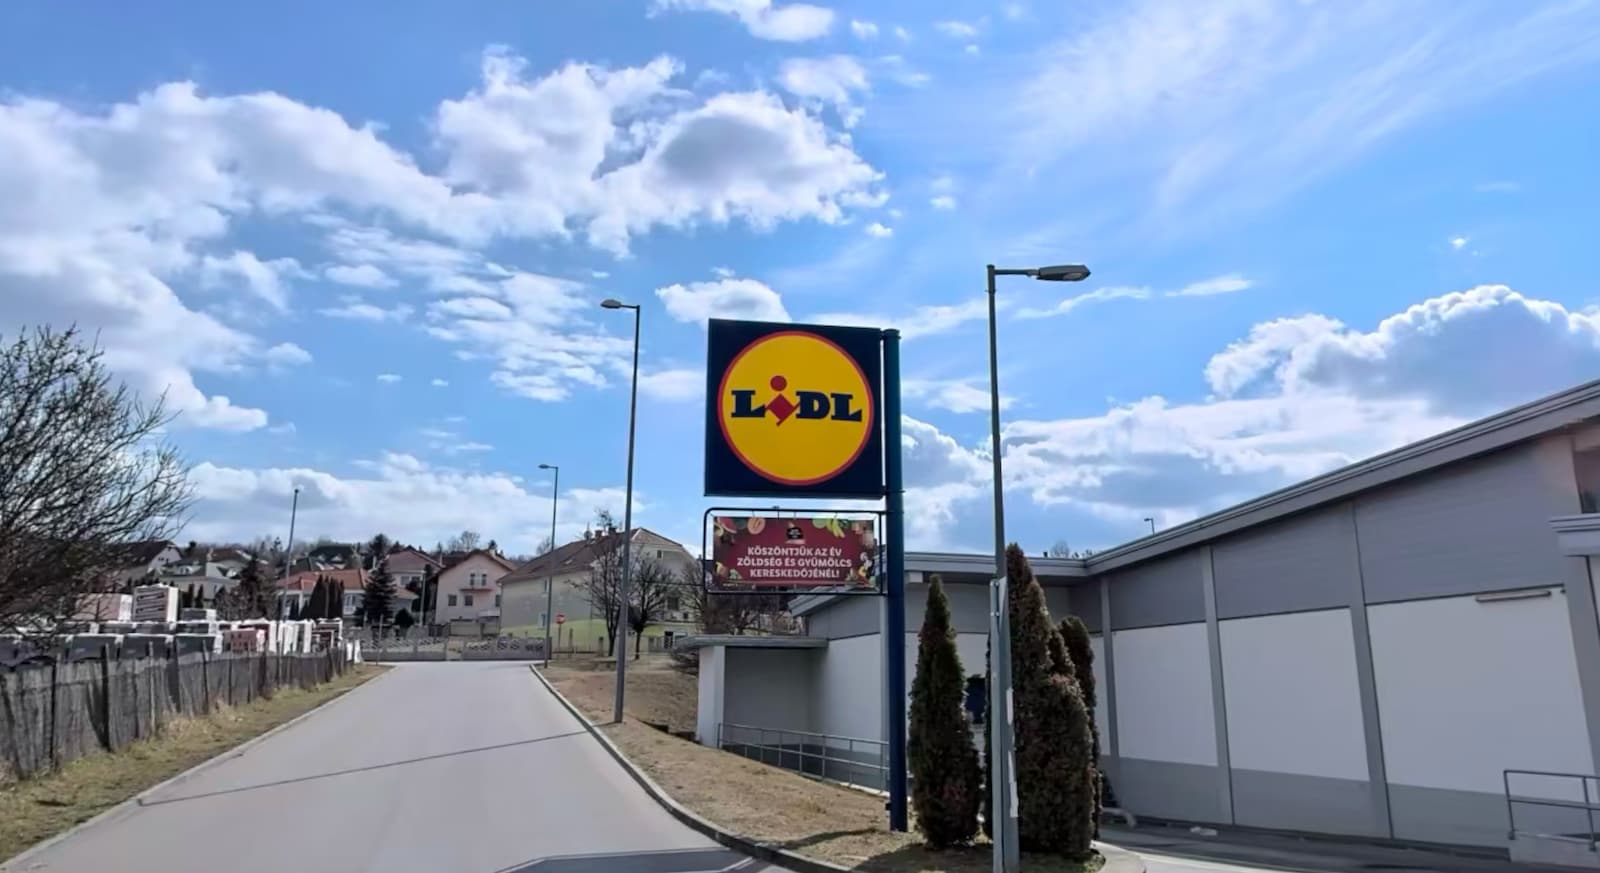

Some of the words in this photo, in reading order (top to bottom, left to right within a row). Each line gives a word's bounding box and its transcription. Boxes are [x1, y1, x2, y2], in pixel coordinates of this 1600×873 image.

[747, 546, 813, 557] KÖSZÖNTJÜK
[815, 547, 828, 557] AZ
[830, 546, 842, 557] ÉV
[737, 556, 783, 567] ZÖLDSÉG
[785, 557, 796, 567] ÉS
[798, 558, 852, 568] GYÜMÖLCS
